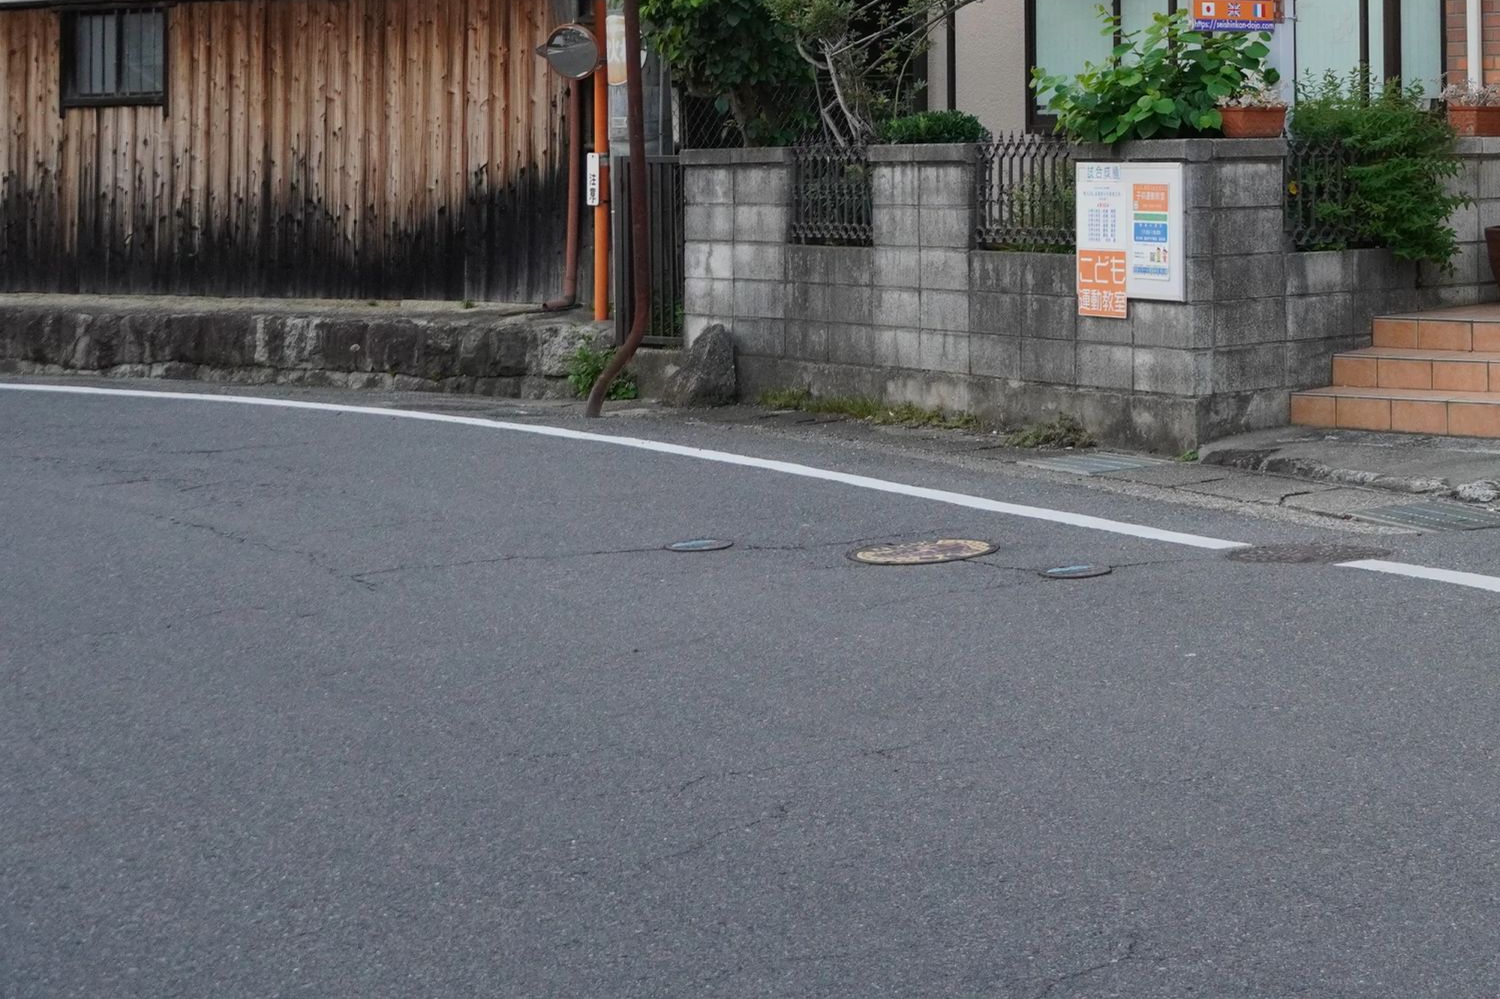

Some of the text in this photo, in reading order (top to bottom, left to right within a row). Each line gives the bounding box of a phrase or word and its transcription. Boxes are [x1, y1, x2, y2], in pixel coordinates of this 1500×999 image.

[1079, 255, 1126, 284] こども
[1079, 288, 1127, 313] 運動教室
